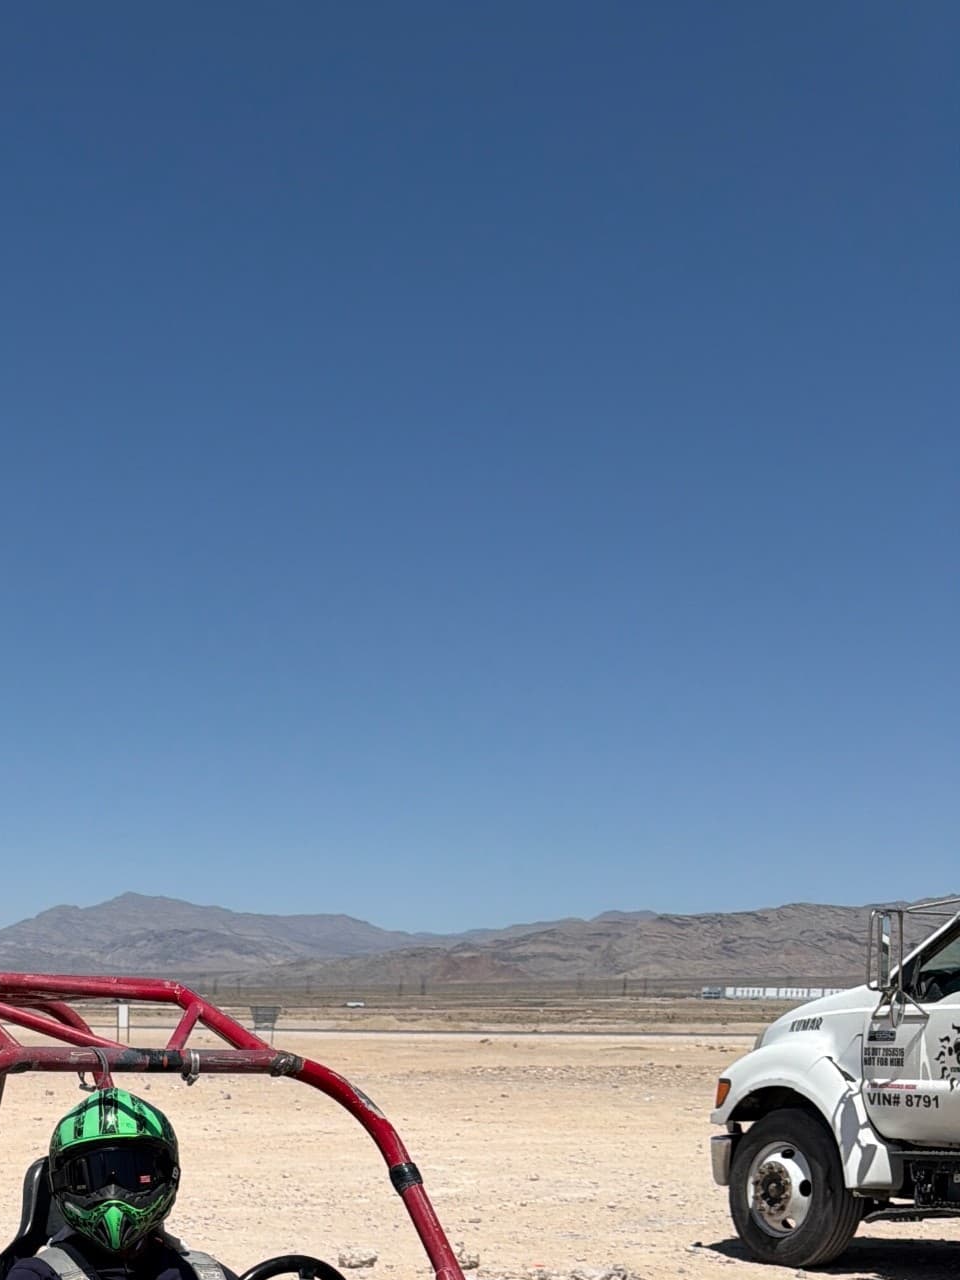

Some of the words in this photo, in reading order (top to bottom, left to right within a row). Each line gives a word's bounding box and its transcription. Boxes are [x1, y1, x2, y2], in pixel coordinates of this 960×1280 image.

[877, 1058, 888, 1066] FOR
[867, 1092, 900, 1107] VIN#
[905, 1094, 939, 1109] 8791
